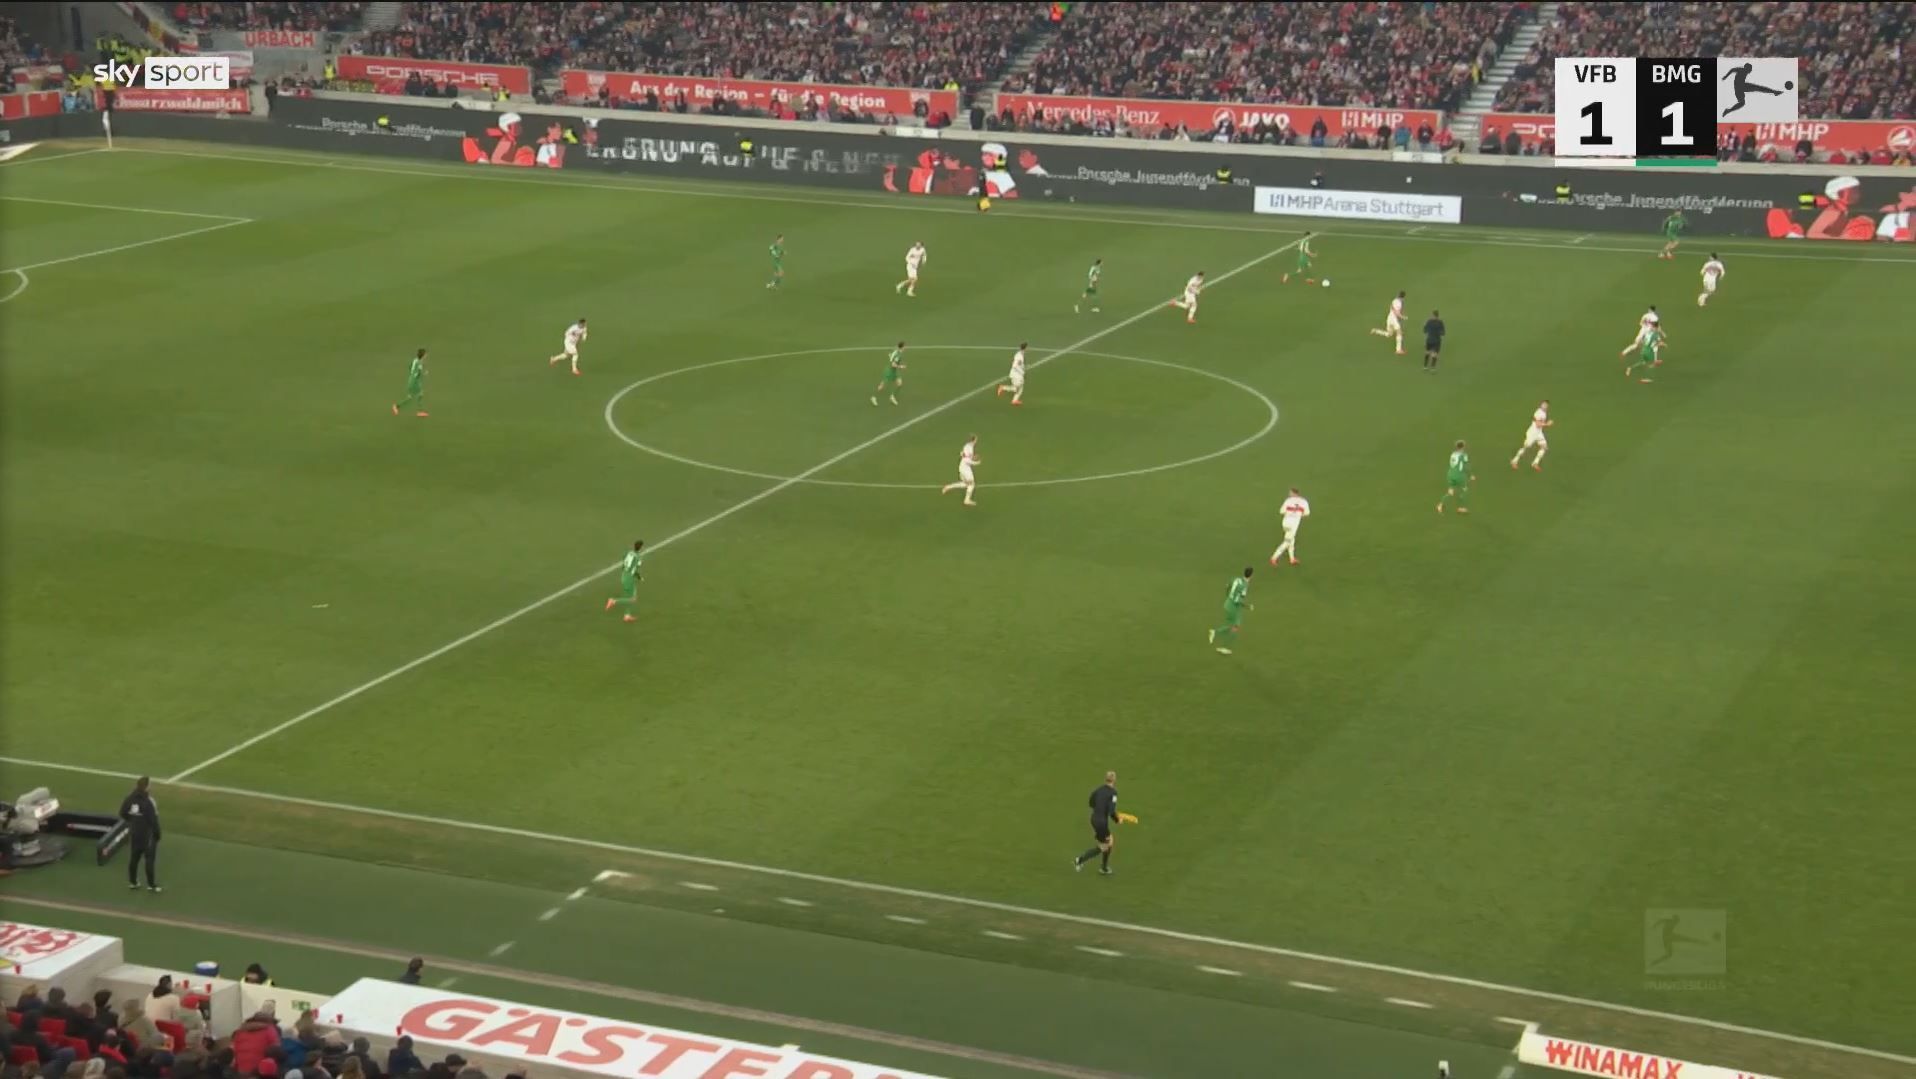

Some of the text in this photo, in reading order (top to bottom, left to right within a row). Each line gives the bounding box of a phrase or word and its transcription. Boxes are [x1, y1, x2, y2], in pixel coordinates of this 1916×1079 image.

[244, 31, 316, 48] URBACH
[1370, 198, 1444, 219] Stuttgart
[1545, 1039, 1684, 1079] WINAMAX
